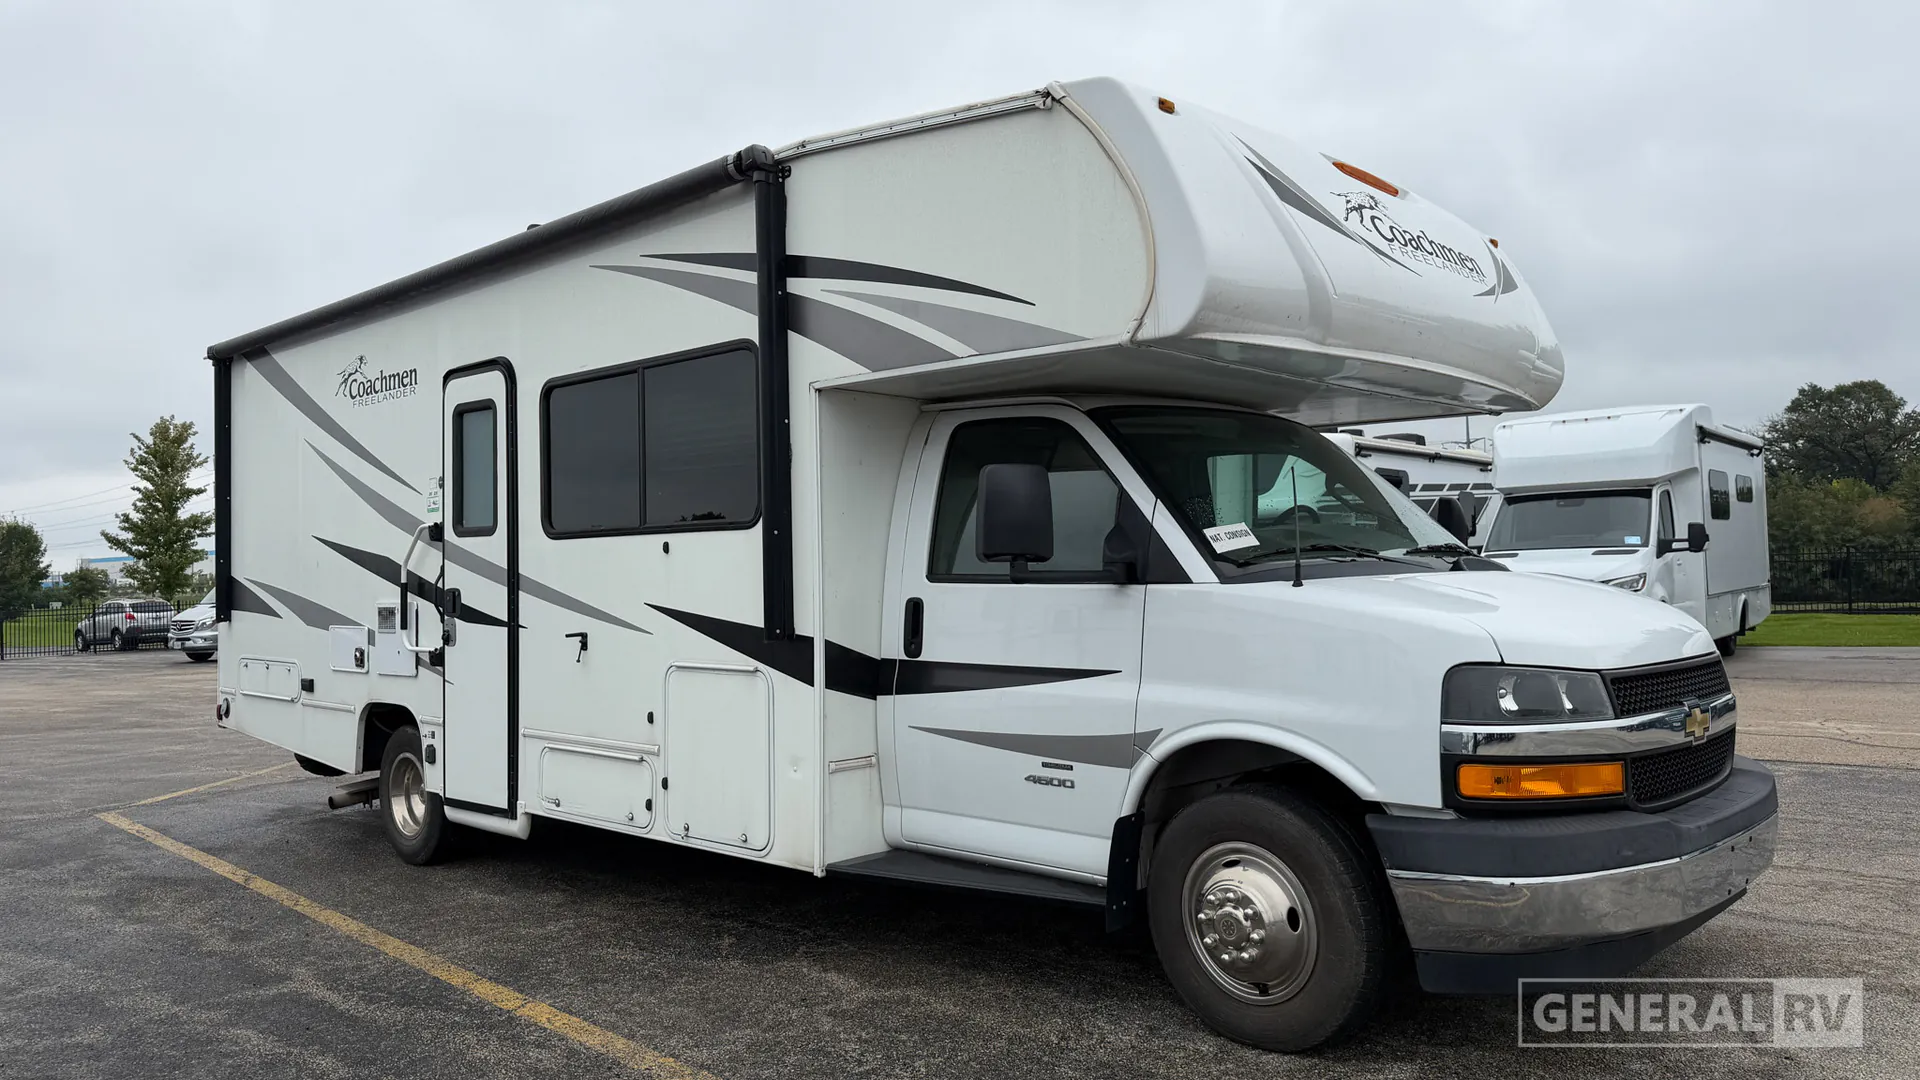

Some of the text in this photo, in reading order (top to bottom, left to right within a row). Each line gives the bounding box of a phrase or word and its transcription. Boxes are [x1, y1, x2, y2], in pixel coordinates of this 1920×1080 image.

[1369, 214, 1487, 279] Coachmen
[1389, 243, 1489, 286] FREELANDER
[349, 367, 418, 400] Coachmen
[352, 386, 417, 408] FREELANDER
[1209, 529, 1252, 543] NAT. CONSIGN
